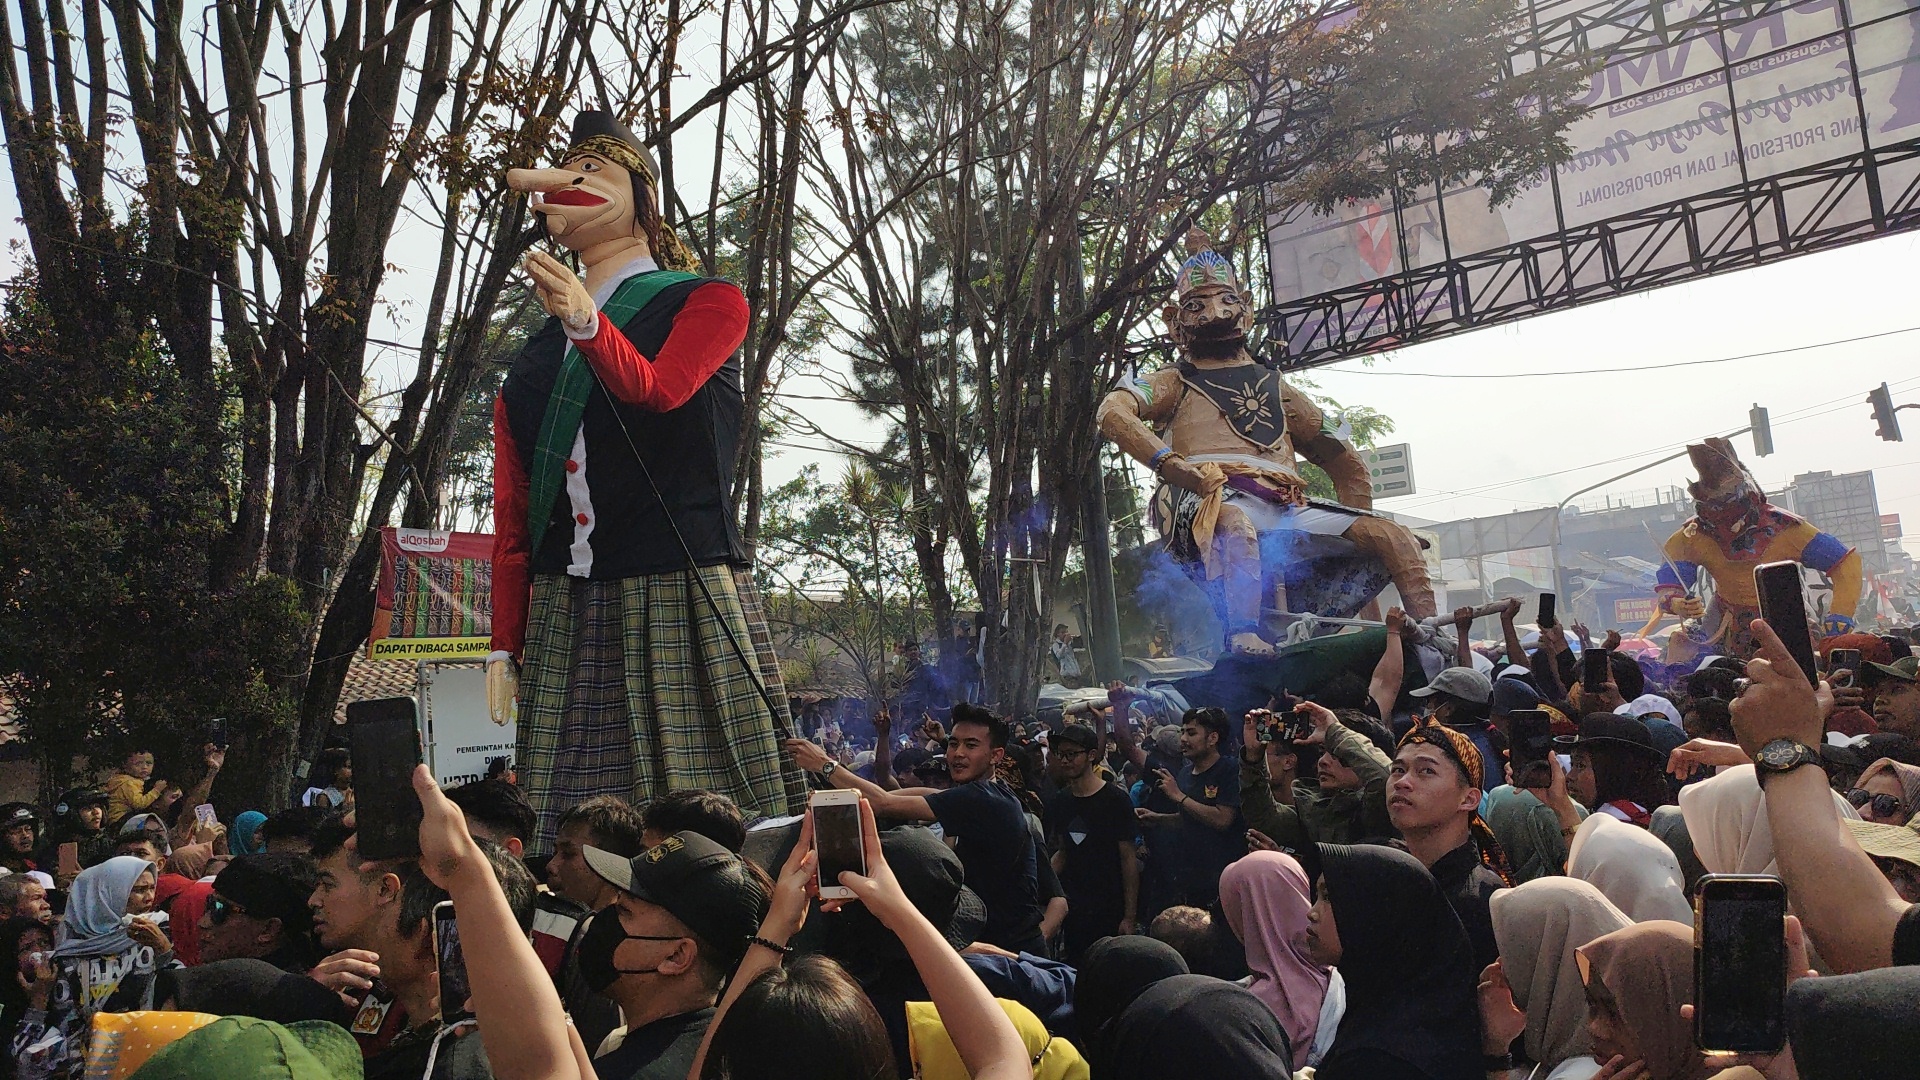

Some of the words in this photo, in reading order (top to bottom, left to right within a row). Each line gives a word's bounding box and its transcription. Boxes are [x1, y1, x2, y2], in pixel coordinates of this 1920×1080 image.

[376, 644, 414, 654] DAPAT
[415, 643, 454, 653] DIBACA
[456, 642, 491, 652] SAMPA
[456, 744, 503, 754] PEMERINTAH
[505, 742, 516, 750] KA
